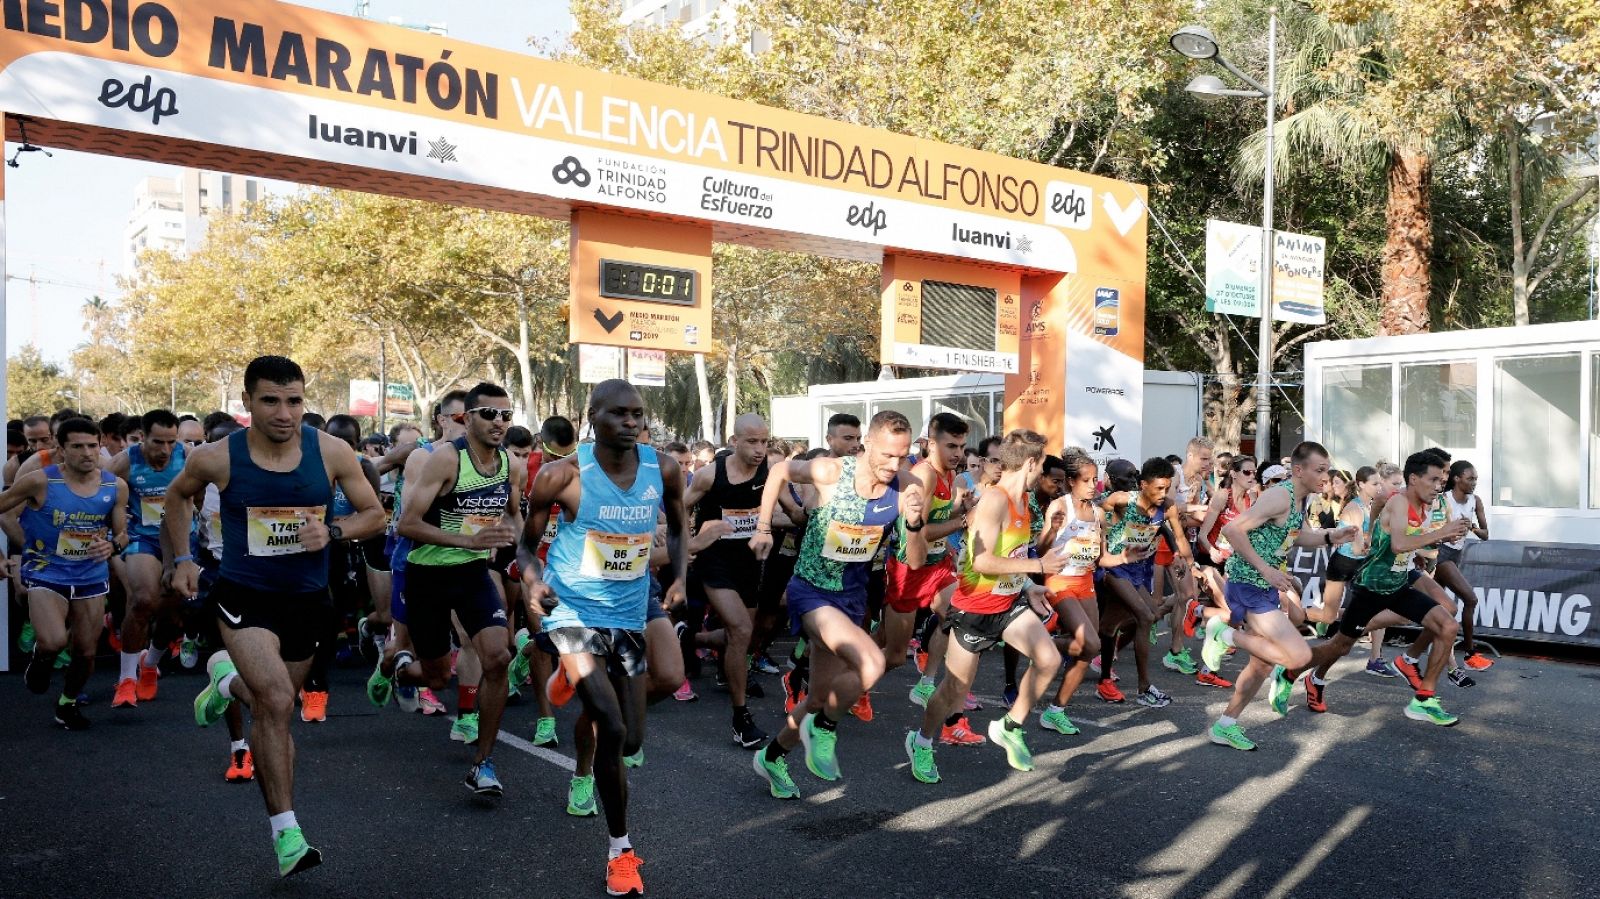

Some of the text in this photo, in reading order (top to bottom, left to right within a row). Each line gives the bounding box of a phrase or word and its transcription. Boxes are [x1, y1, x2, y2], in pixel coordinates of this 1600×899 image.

[4, 0, 1040, 218] EDIO MARATÓN VALENCIA TRINIDAD ALFONSO
[98, 75, 179, 125] edp
[308, 114, 418, 156] luanvi
[598, 157, 666, 175] FUNDACIÓN
[598, 169, 667, 190] TRINIDAD
[702, 177, 759, 199] Cultura
[597, 184, 667, 204] ALFONSO
[700, 194, 773, 219] Esfuerzo
[1051, 187, 1086, 223] edp
[846, 201, 888, 237] edp
[951, 222, 1012, 249] luanvi
[643, 332, 659, 340] 2019
[1027, 321, 1046, 334] AIMS
[954, 352, 995, 369] FINISHER
[1085, 386, 1124, 396] POWERADE
[613, 549, 627, 559] 86
[604, 560, 632, 572] PACE
